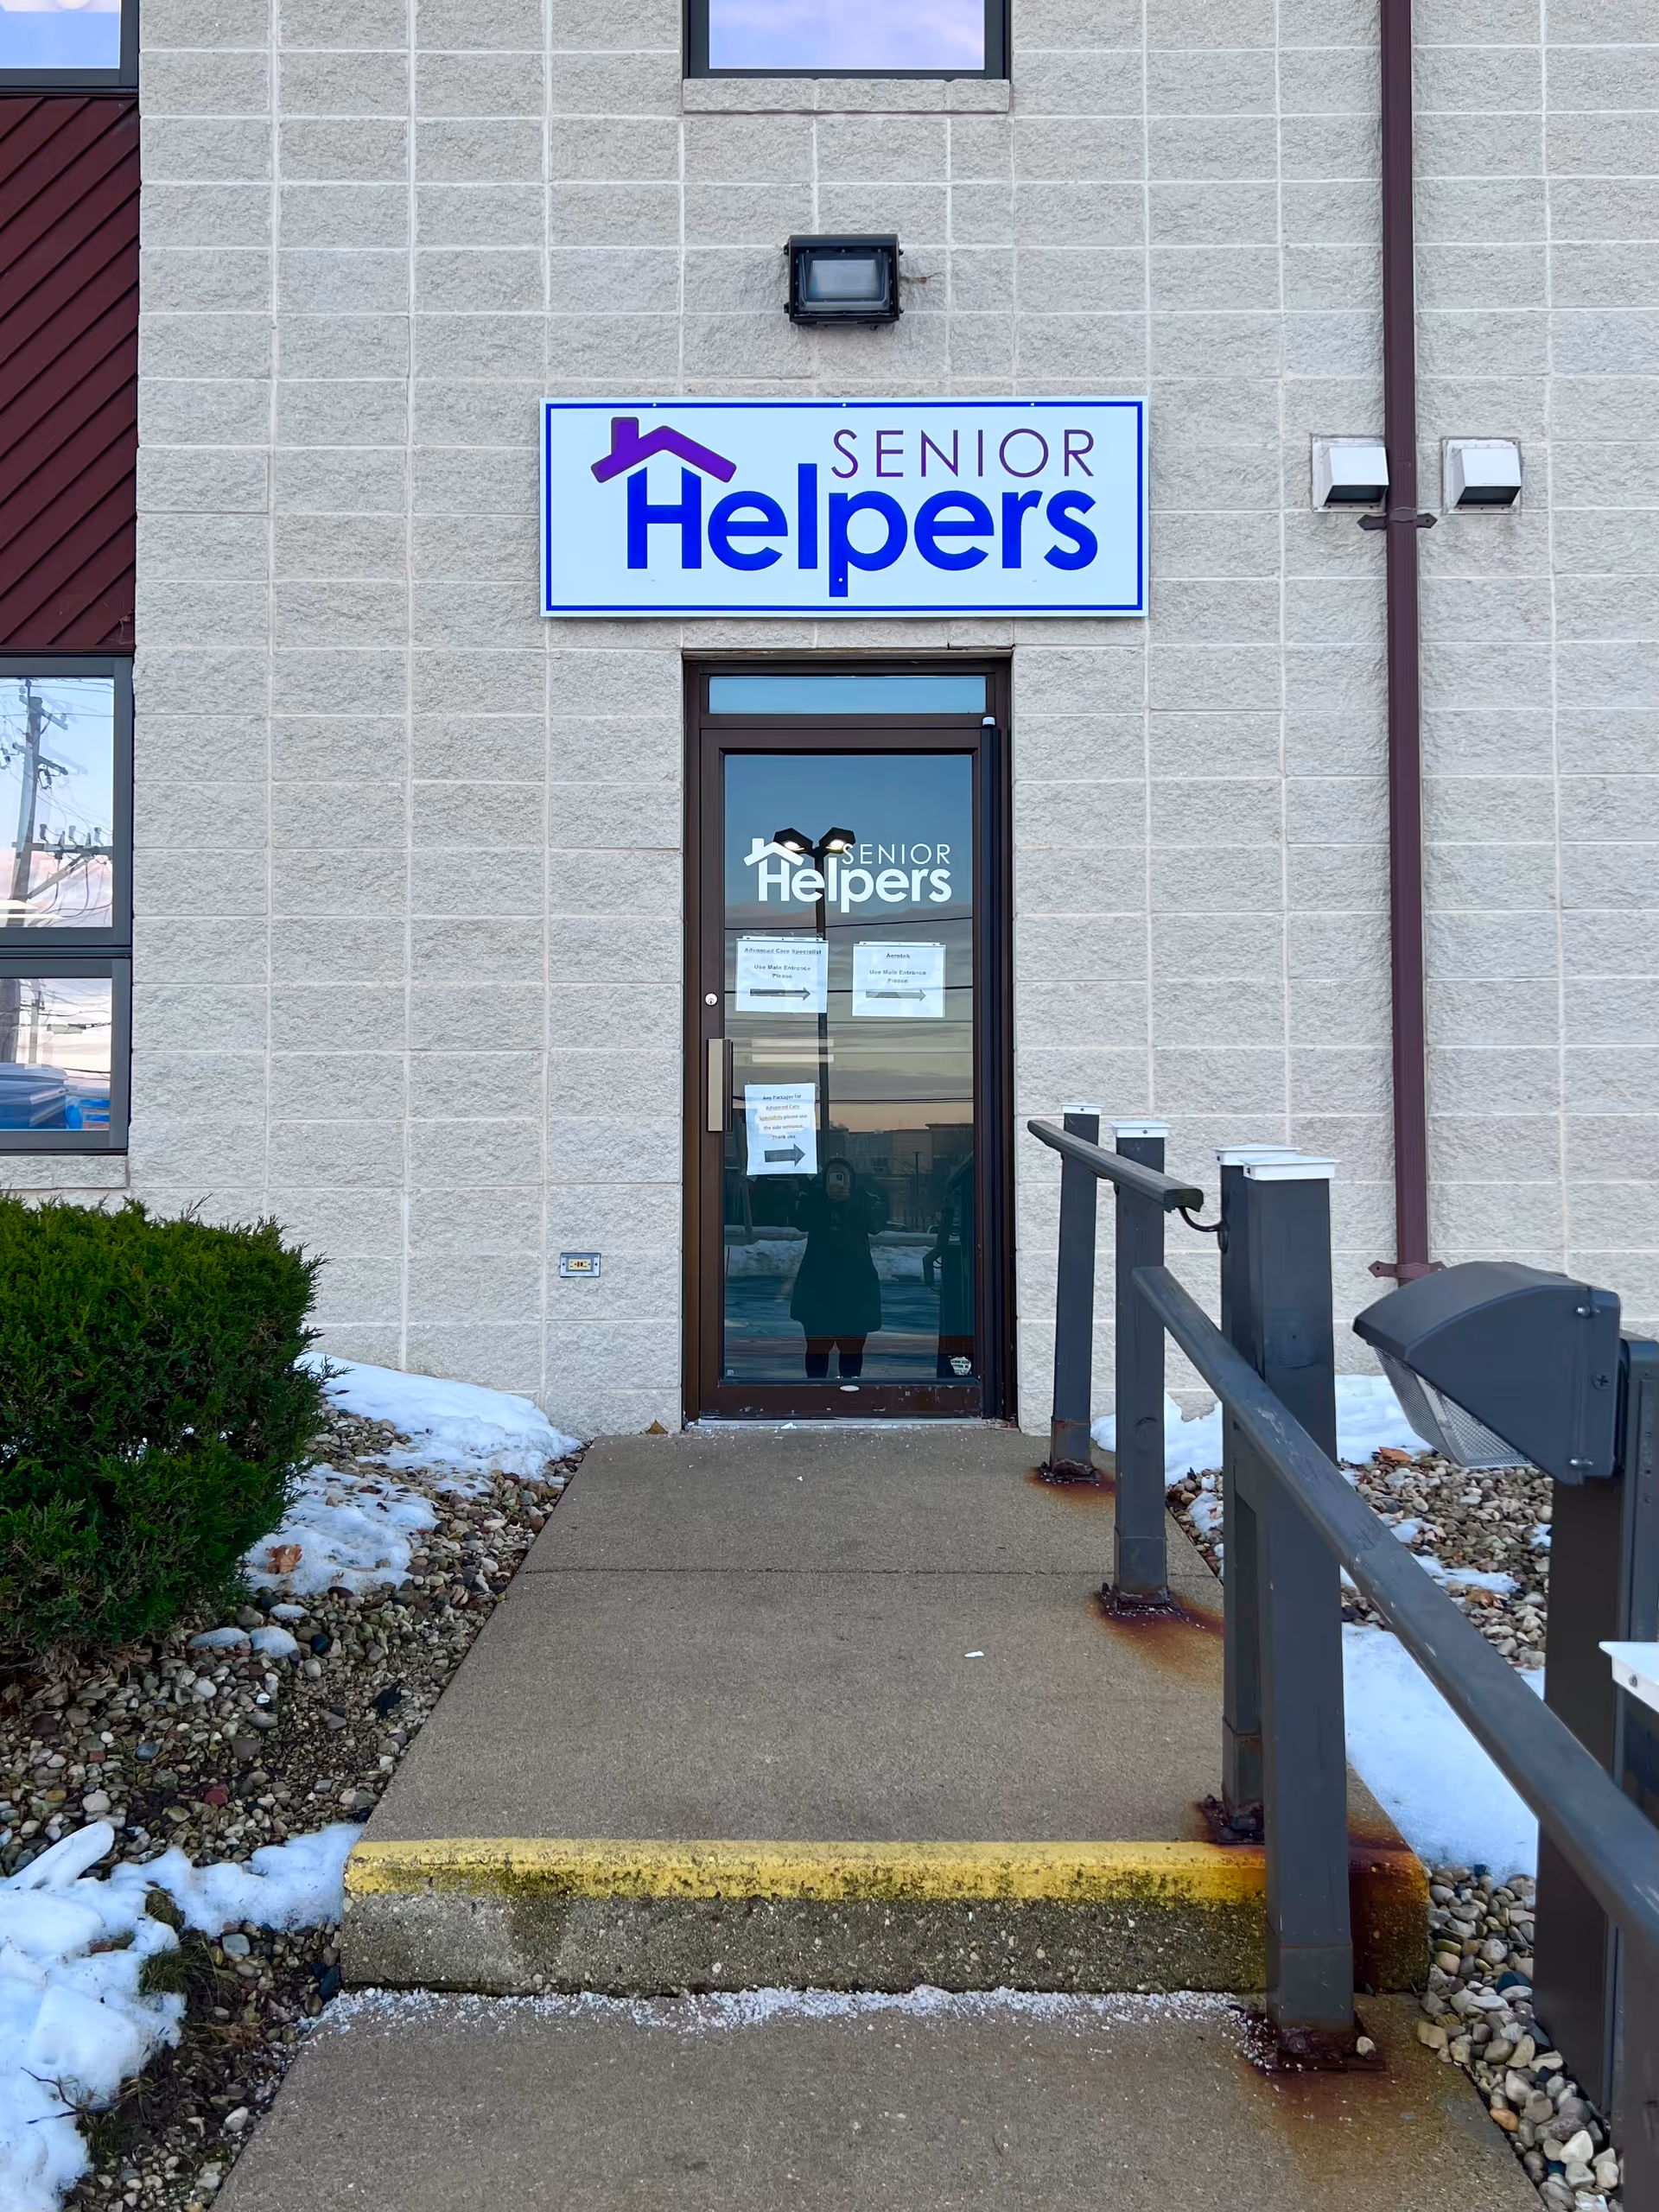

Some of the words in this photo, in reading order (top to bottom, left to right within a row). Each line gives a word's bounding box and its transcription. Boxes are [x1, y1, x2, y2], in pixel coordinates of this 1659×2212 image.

[831, 428, 1094, 479] SENIOR
[627, 462, 1098, 597] Helpers
[842, 842, 950, 865] SENIOR
[758, 857, 952, 913] Helpers
